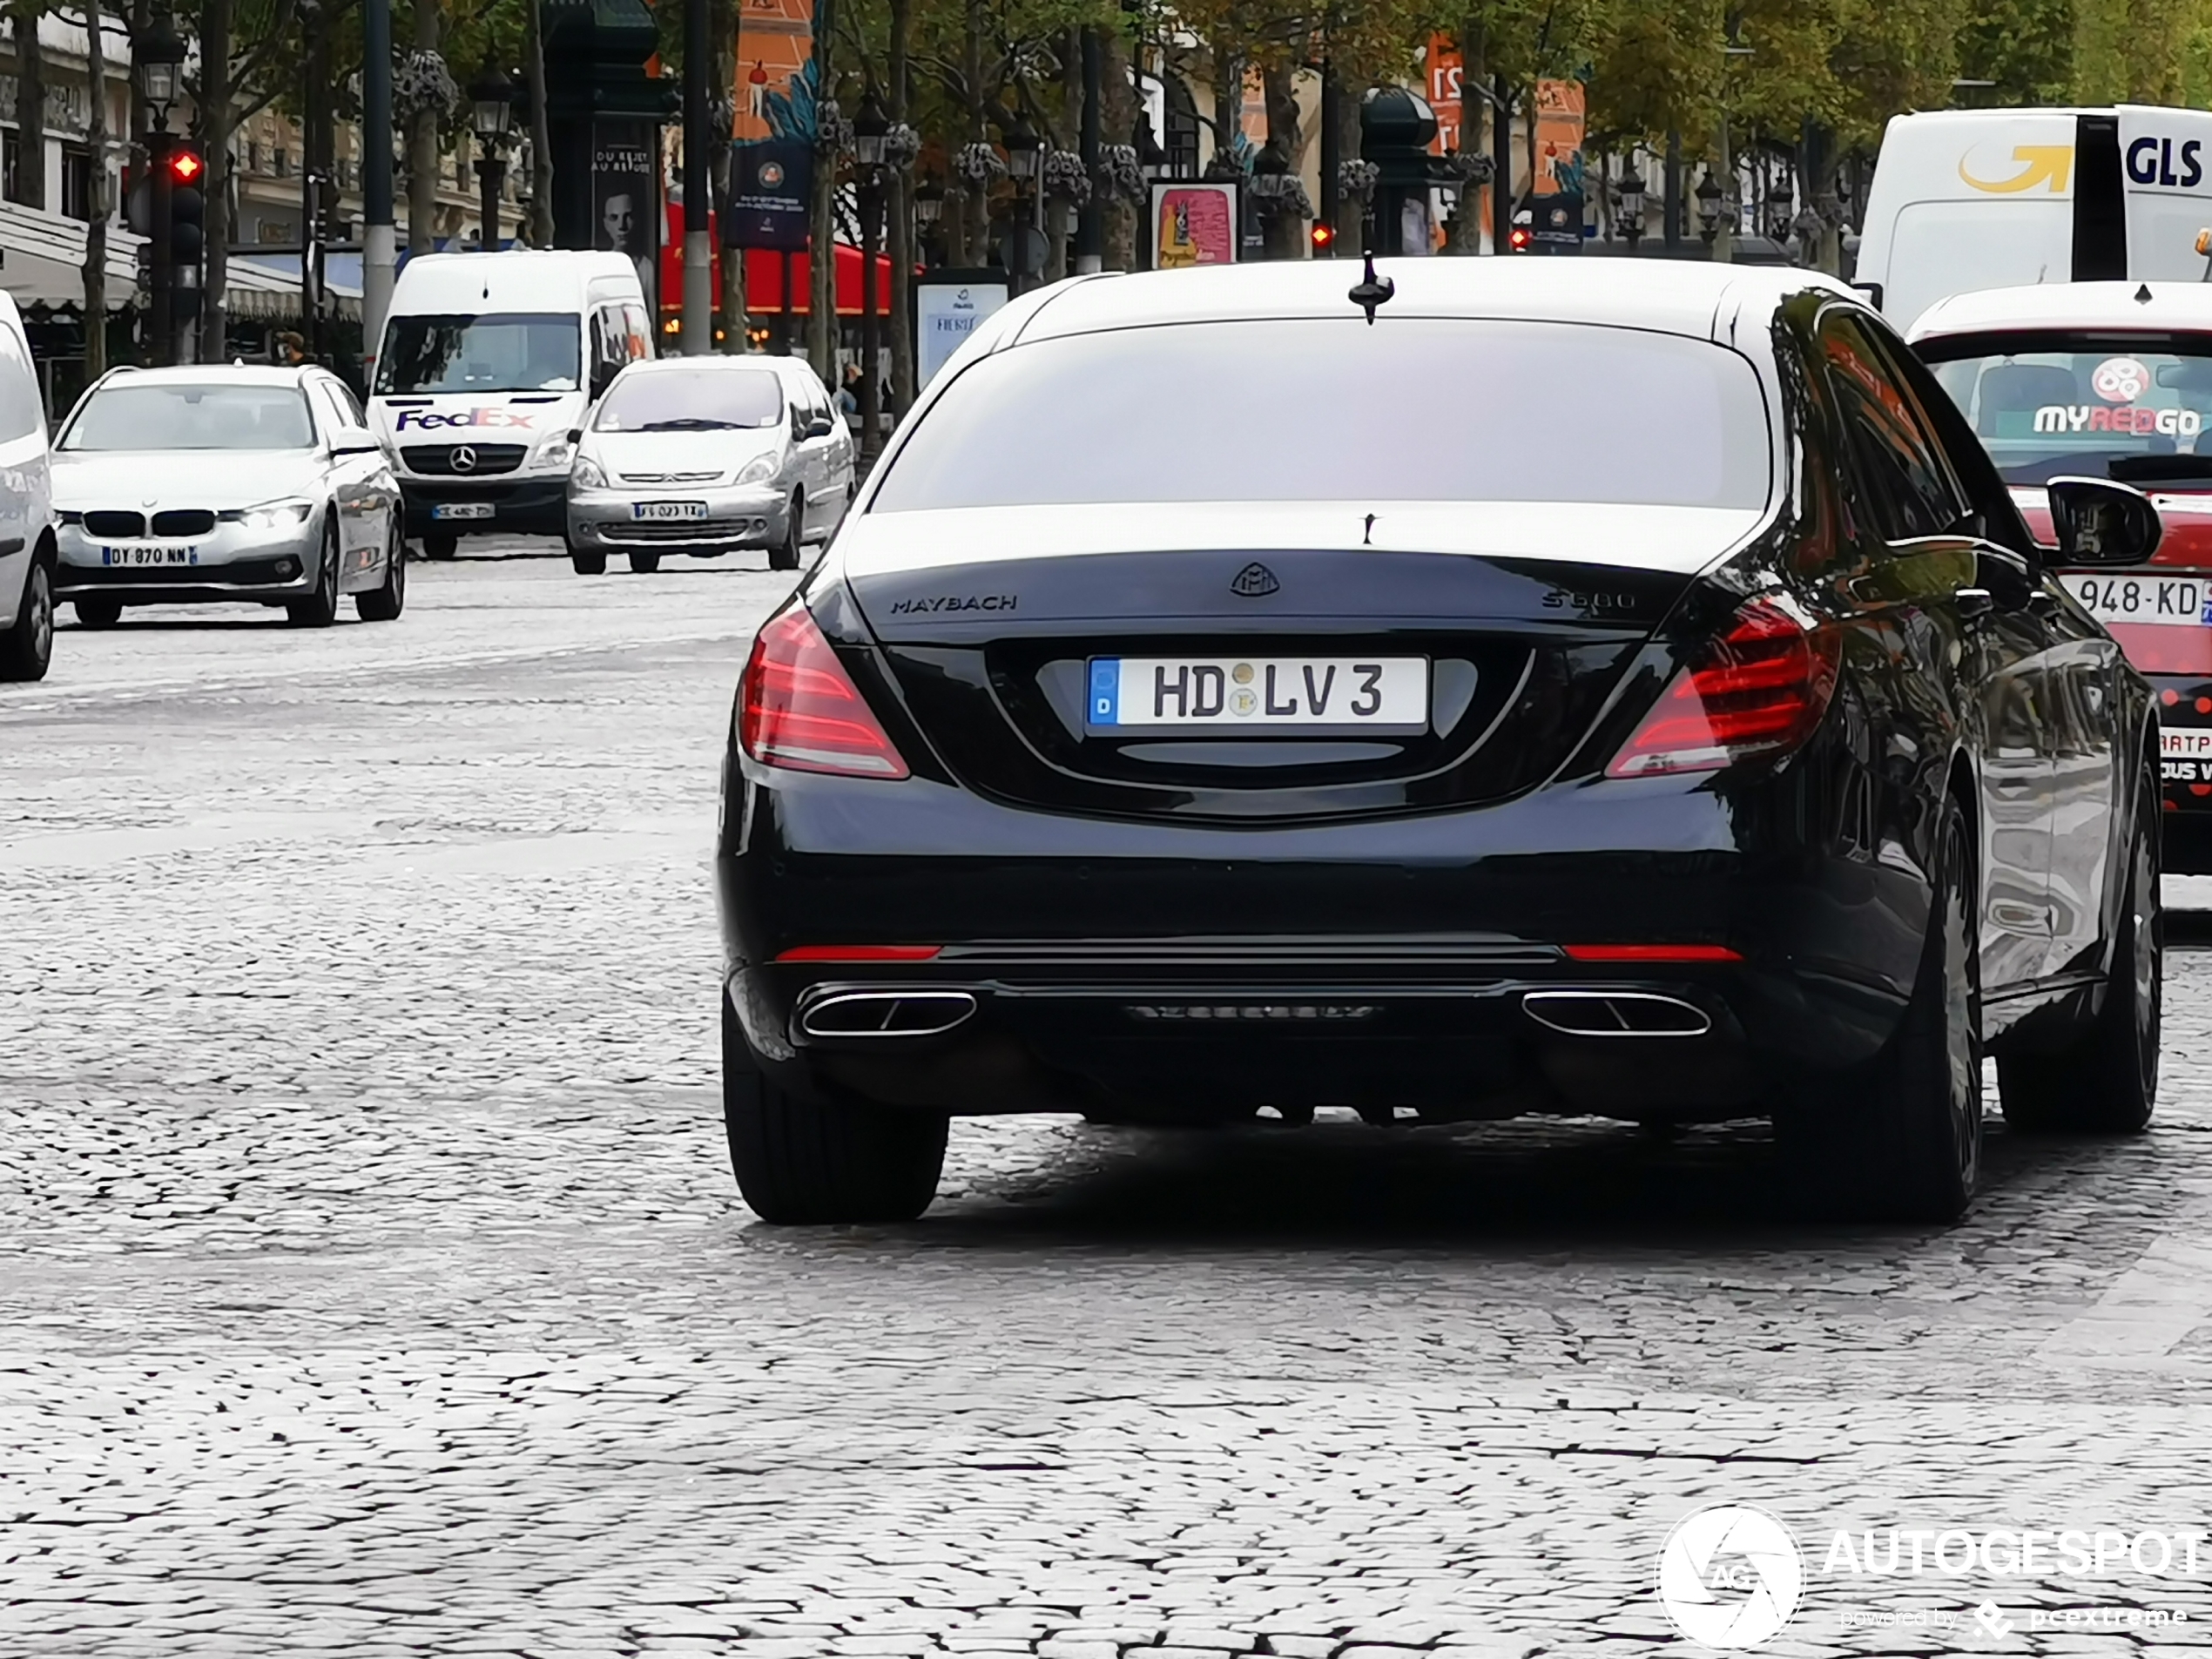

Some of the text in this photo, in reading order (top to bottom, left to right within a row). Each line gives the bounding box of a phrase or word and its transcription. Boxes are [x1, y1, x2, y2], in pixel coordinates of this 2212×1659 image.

[2126, 137, 2202, 187] GLS
[396, 408, 535, 431] FedEx
[2033, 406, 2200, 435] MYREDGO
[890, 595, 1017, 614] MAYBACH
